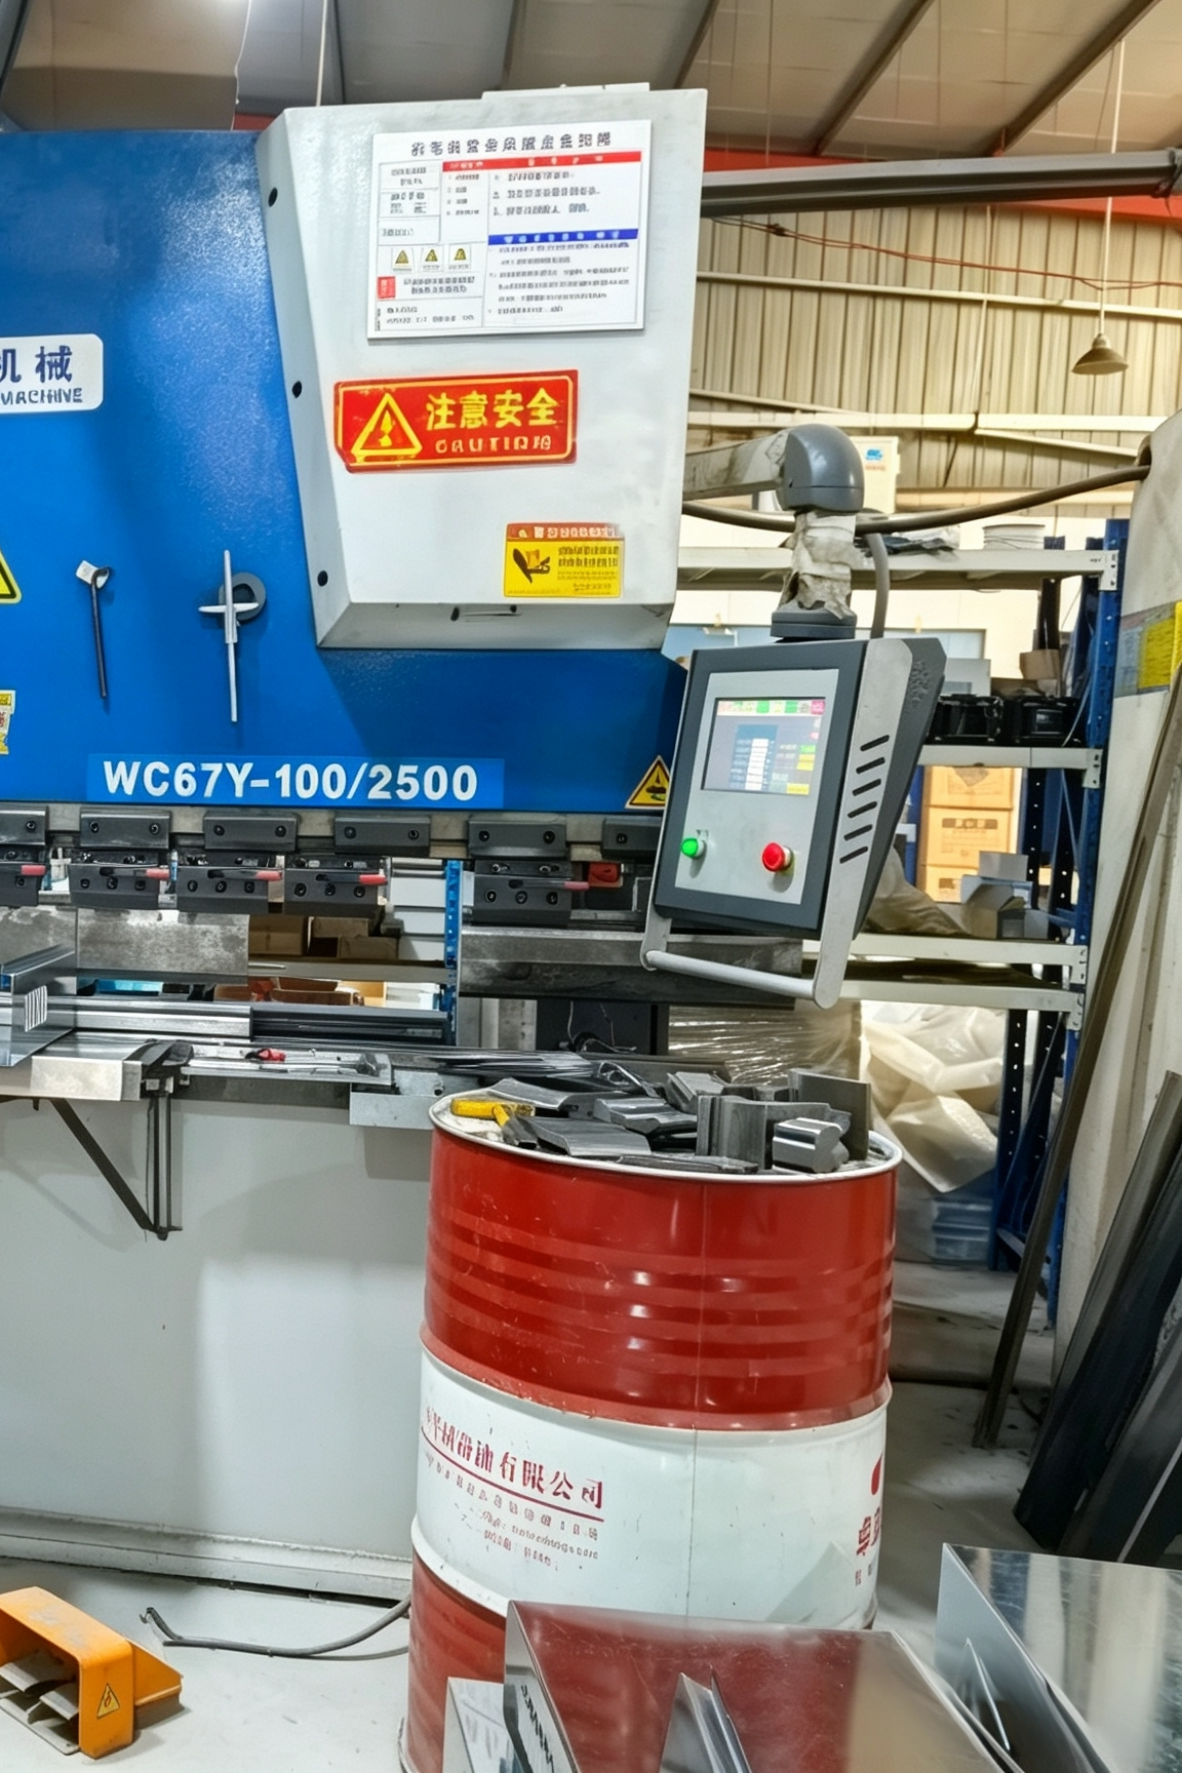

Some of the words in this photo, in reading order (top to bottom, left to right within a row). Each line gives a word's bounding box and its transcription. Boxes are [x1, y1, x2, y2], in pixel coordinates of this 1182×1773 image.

[425, 387, 560, 431] 注意安全
[103, 760, 478, 801] WC67Y-100/2500
